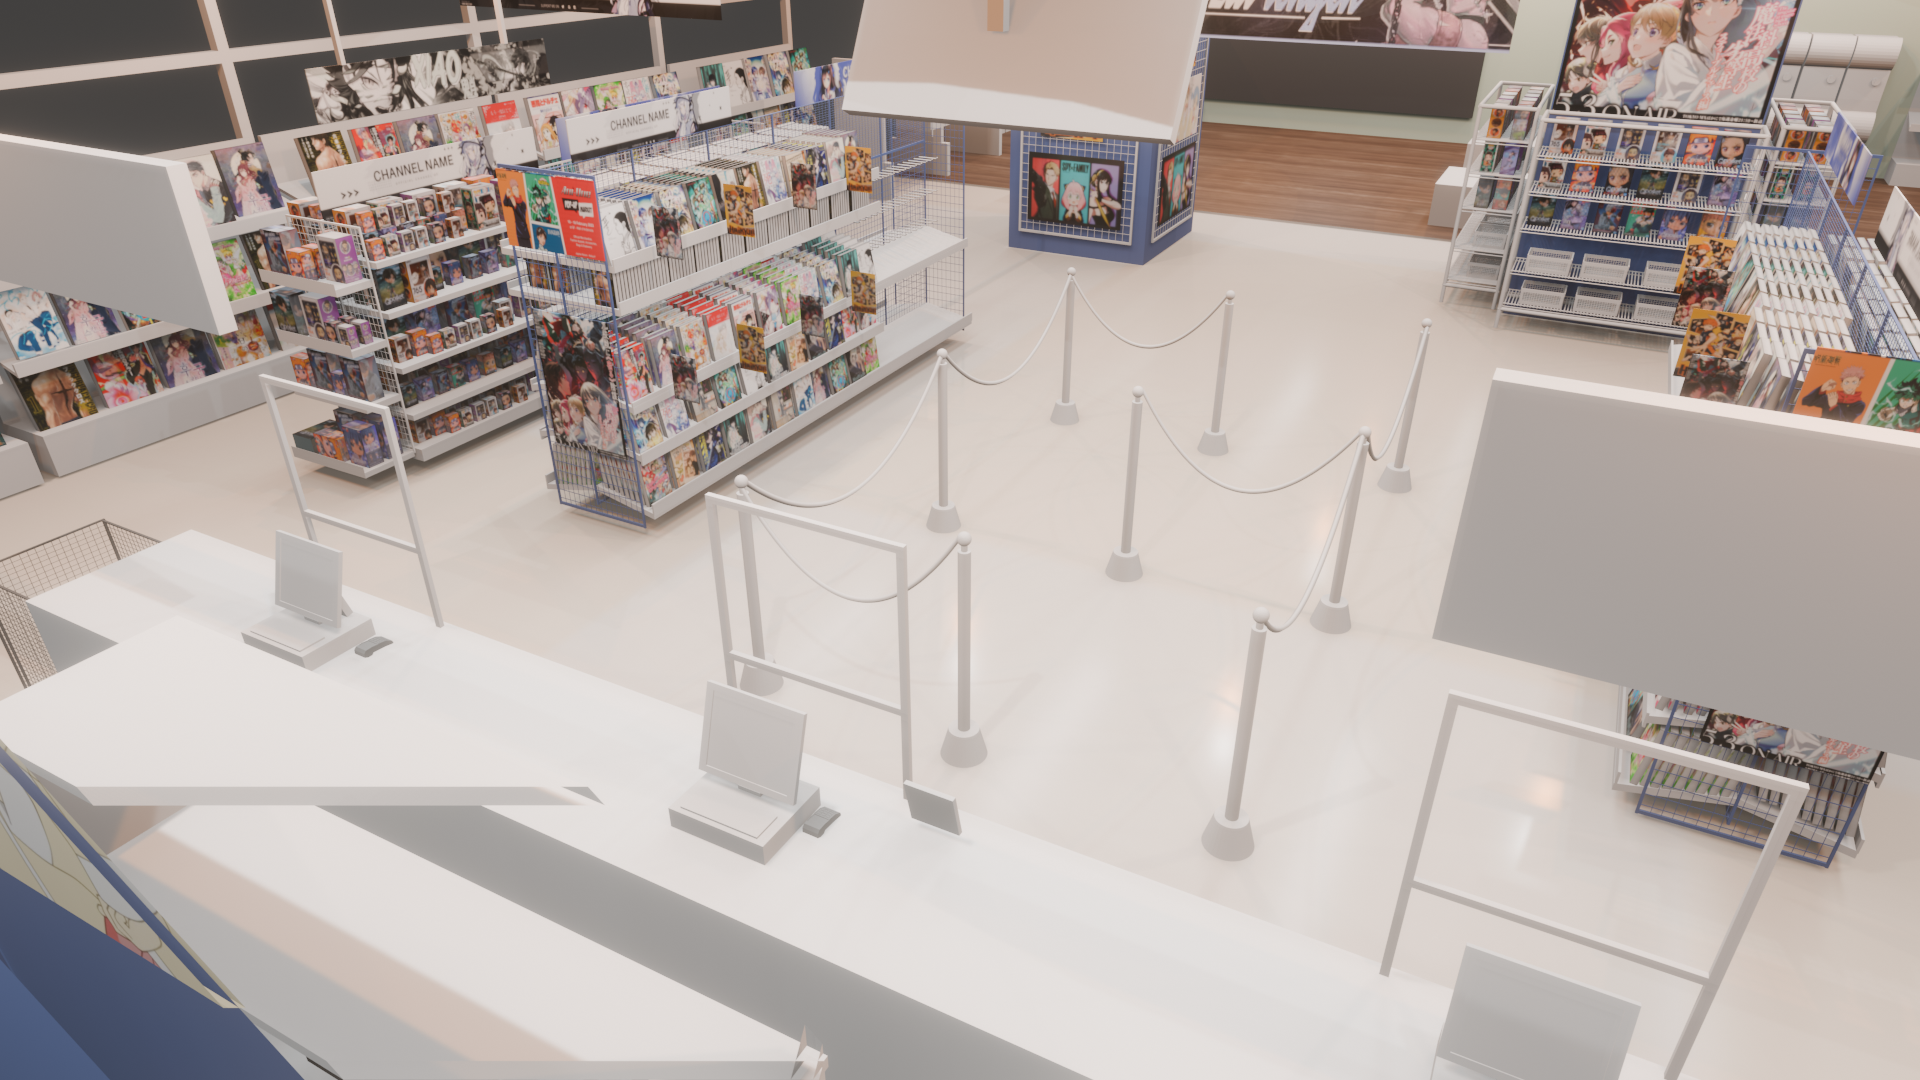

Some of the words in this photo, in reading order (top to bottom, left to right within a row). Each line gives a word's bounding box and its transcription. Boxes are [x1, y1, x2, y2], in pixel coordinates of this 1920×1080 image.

[410, 49, 462, 89] XIAO
[1556, 92, 1597, 113] 53
[610, 113, 648, 131] CHANNEL
[648, 108, 670, 122] NAME
[373, 161, 424, 182] CHANNEL
[425, 154, 454, 170] NAME
